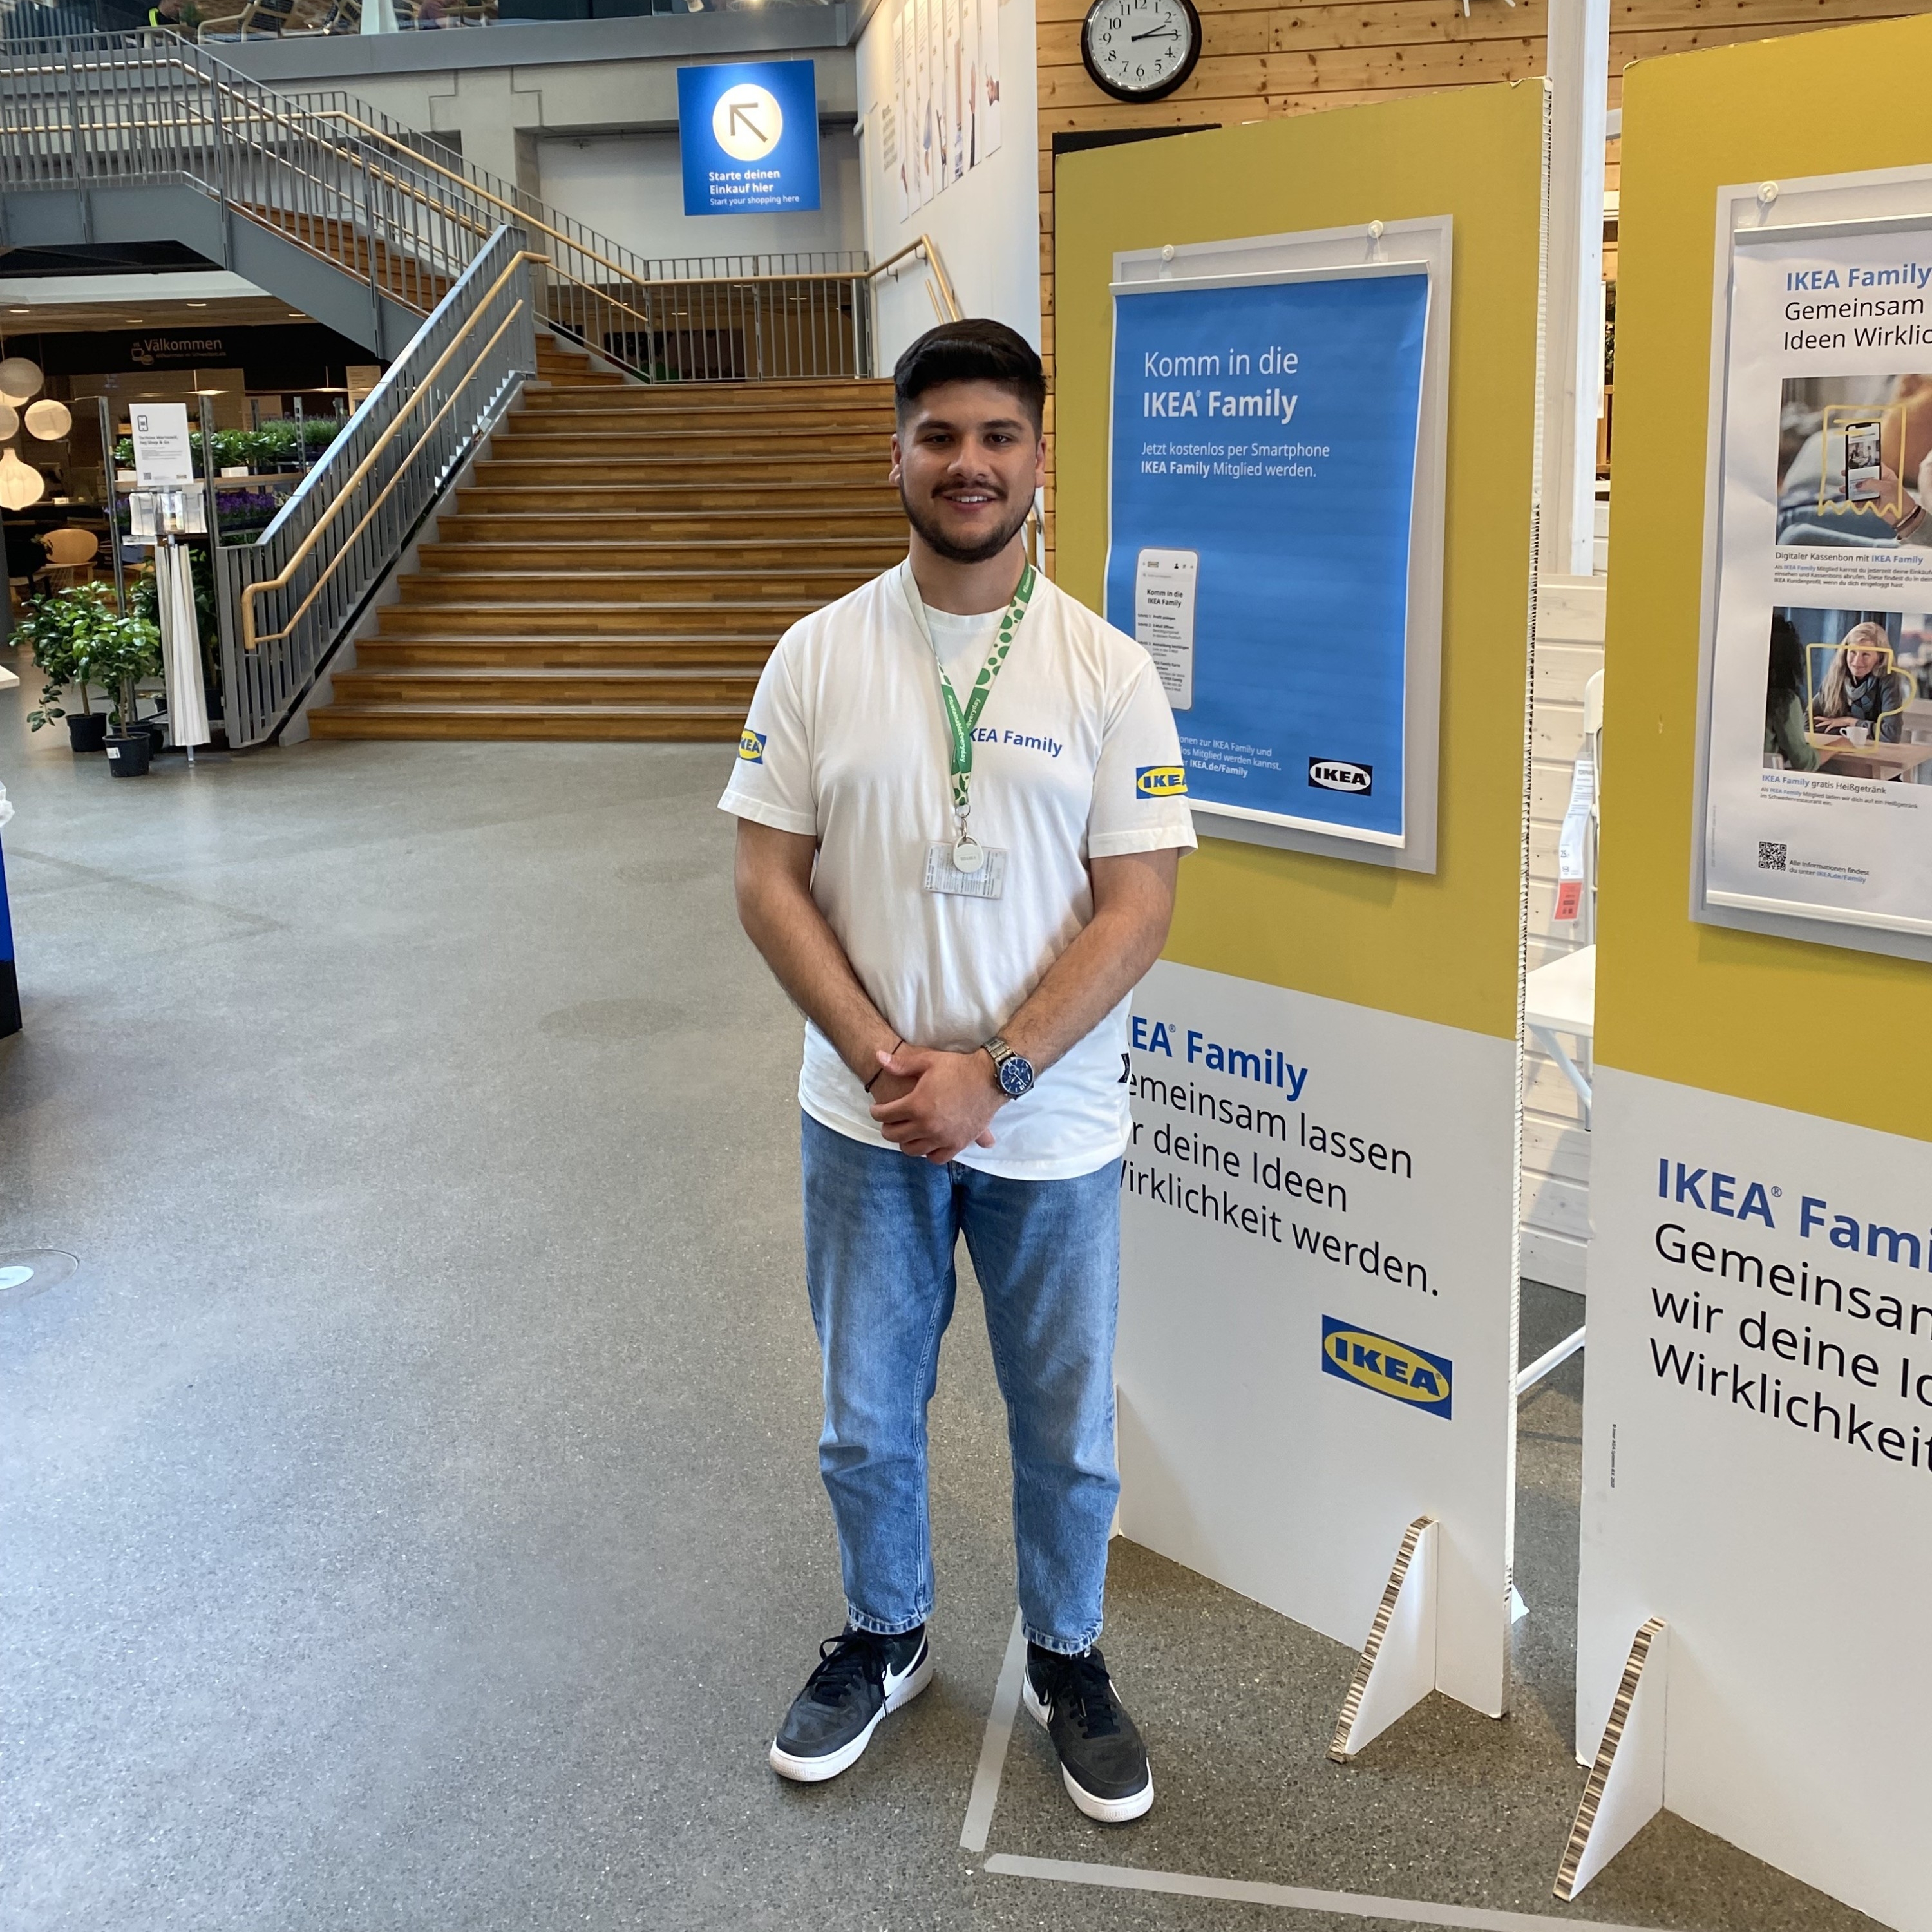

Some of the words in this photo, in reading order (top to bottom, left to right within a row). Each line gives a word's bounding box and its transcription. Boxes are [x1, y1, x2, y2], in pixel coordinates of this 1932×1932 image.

[1121, 4, 1130, 15] 11
[1135, 0, 1147, 9] 12
[1109, 17, 1121, 30] 10
[1164, 12, 1172, 23] 2
[1103, 33, 1112, 46] 9
[1171, 29, 1179, 41] 3
[1108, 50, 1117, 61] 8
[1164, 46, 1173, 58] 4
[1122, 61, 1129, 72] 7
[1136, 64, 1144, 77] 6
[1155, 59, 1162, 71] 5
[709, 171, 741, 182] Starte
[744, 169, 780, 180] deinen
[710, 183, 750, 194] Einkauf
[752, 182, 773, 192] hier
[748, 196, 781, 204] shopping
[1787, 270, 1840, 291] IKEA
[1848, 263, 1932, 289] Family
[1785, 298, 1924, 321] Gemeinsam
[144, 338, 222, 352] Välkommen
[1785, 330, 1845, 350] Ideen
[1144, 352, 1220, 377] Komm
[1229, 348, 1250, 375] in
[1258, 346, 1298, 375] die
[1209, 388, 1298, 425] Family
[1141, 442, 1166, 456] Jetzt
[1170, 442, 1224, 456] kostenlos
[1227, 445, 1248, 460] per
[1251, 443, 1331, 460] Smartphone
[1141, 461, 1167, 474] IKEA
[1170, 462, 1210, 478] Family
[1213, 462, 1262, 479] Mitglied
[1265, 463, 1316, 477] werden.
[1776, 552, 1808, 561] Digitaler
[1810, 553, 1853, 562] Kassenbon
[1893, 556, 1924, 565] Family
[1162, 599, 1181, 608] Family
[969, 728, 998, 743] KEA
[1004, 730, 1063, 757] Family
[1179, 736, 1197, 744] onen
[1213, 740, 1229, 750] IKEA
[1231, 743, 1255, 756] Family
[1256, 748, 1272, 757] und
[1192, 748, 1222, 761] Mitglied
[1224, 755, 1251, 765] werden
[1189, 759, 1248, 778] IKEA.de/Family
[1315, 767, 1367, 786] IKEA
[1762, 775, 1781, 783] IKEA
[1783, 777, 1810, 788] Family
[1836, 782, 1886, 794] Heißgetränk
[1802, 861, 1846, 873] Informationen
[1848, 867, 1870, 876] findest
[1816, 871, 1866, 884] IKEA.de/Family
[1188, 1030, 1308, 1101] Family
[1130, 1074, 1285, 1141] emeinsam
[1300, 1112, 1412, 1179] lassen
[1154, 1123, 1240, 1177] deine
[1253, 1152, 1347, 1212] Ideen
[1120, 1160, 1282, 1243] irklichkeit
[1292, 1223, 1438, 1296] werden.
[1651, 1287, 1723, 1334] wir
[1739, 1311, 1879, 1387] deine
[1335, 1336, 1441, 1397] IKEA
